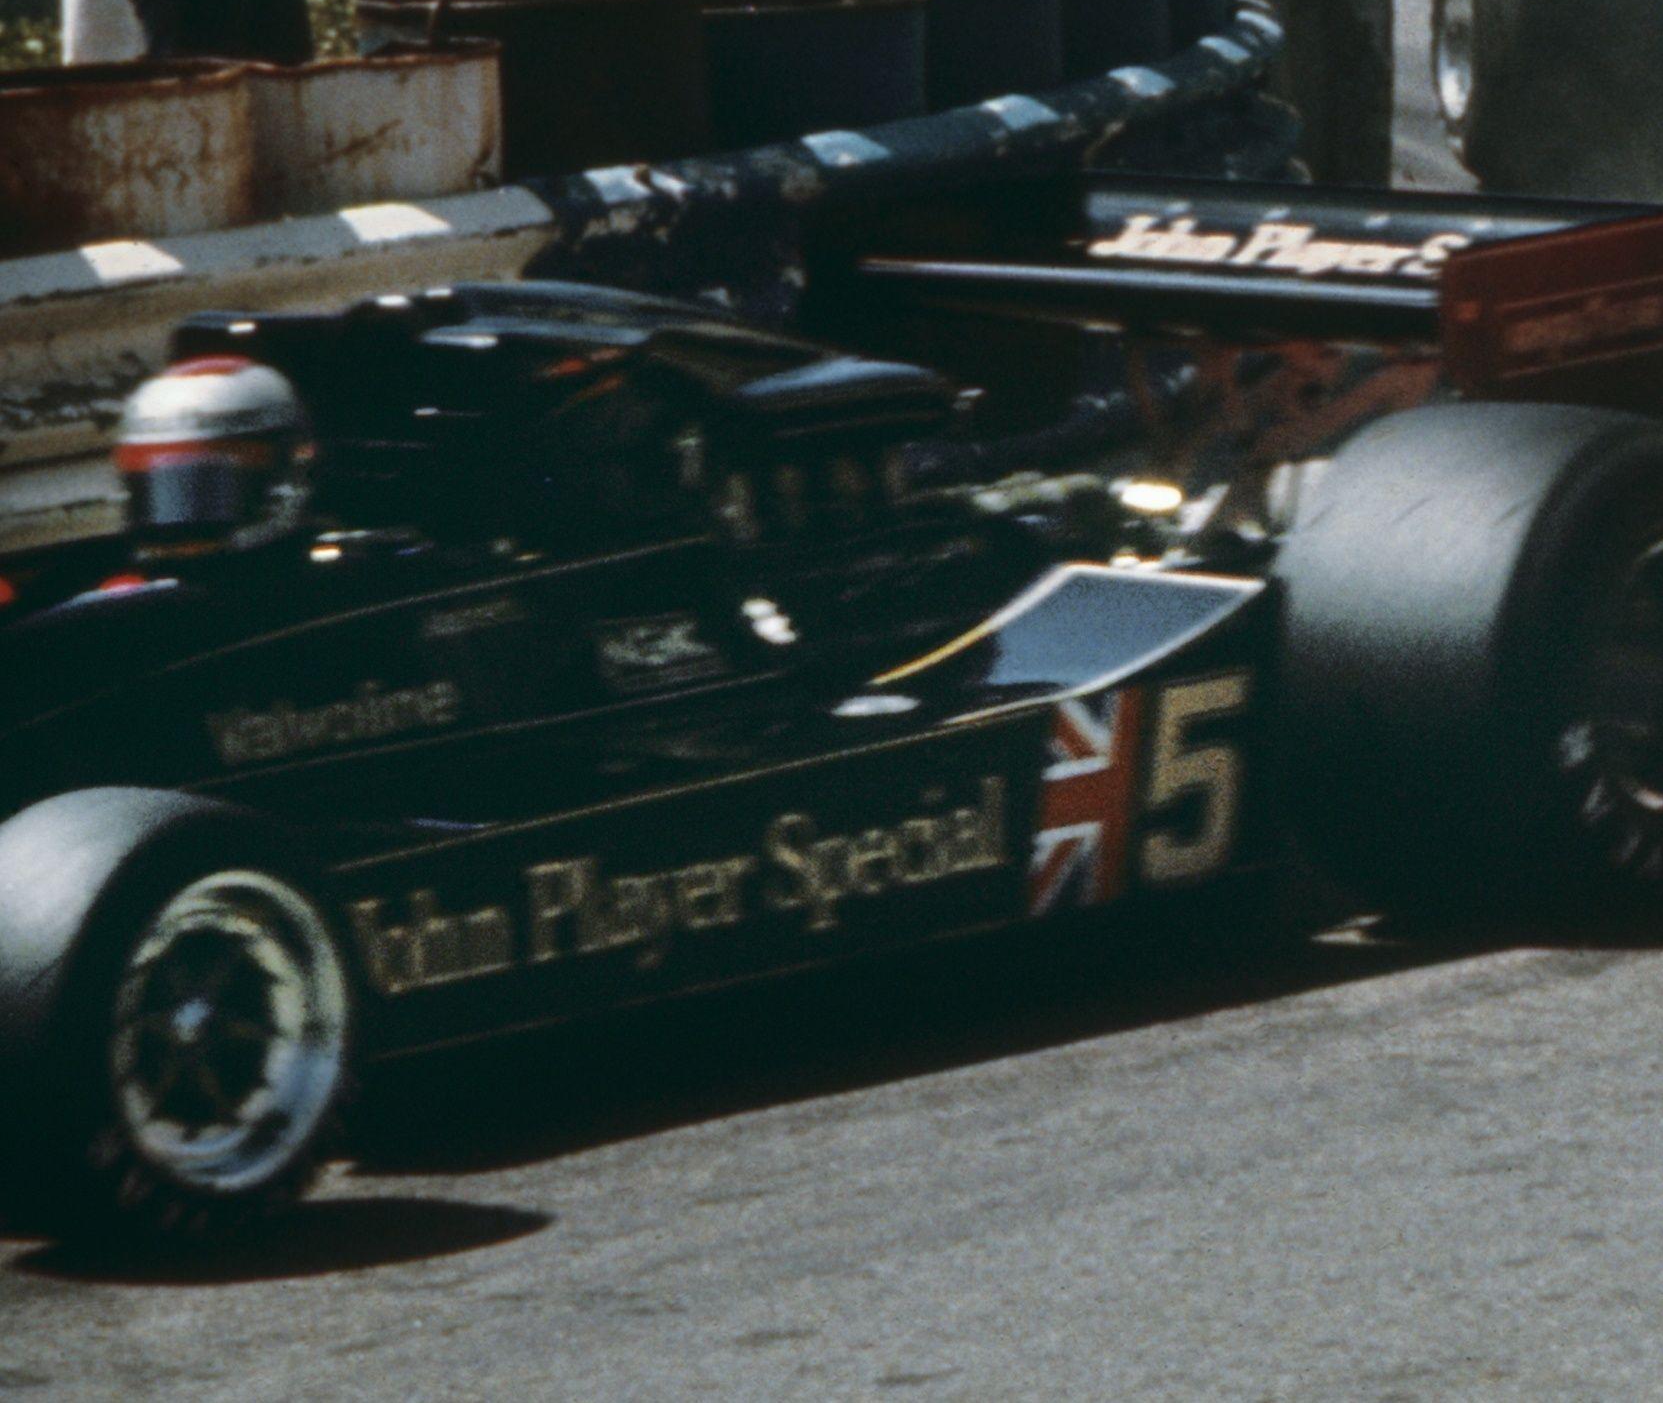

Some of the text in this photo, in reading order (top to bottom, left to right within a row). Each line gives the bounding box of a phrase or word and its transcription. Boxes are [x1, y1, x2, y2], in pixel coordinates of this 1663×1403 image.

[1087, 214, 1472, 281] John Player S
[1141, 668, 1250, 882] 5
[347, 774, 1006, 996] John Player Special
